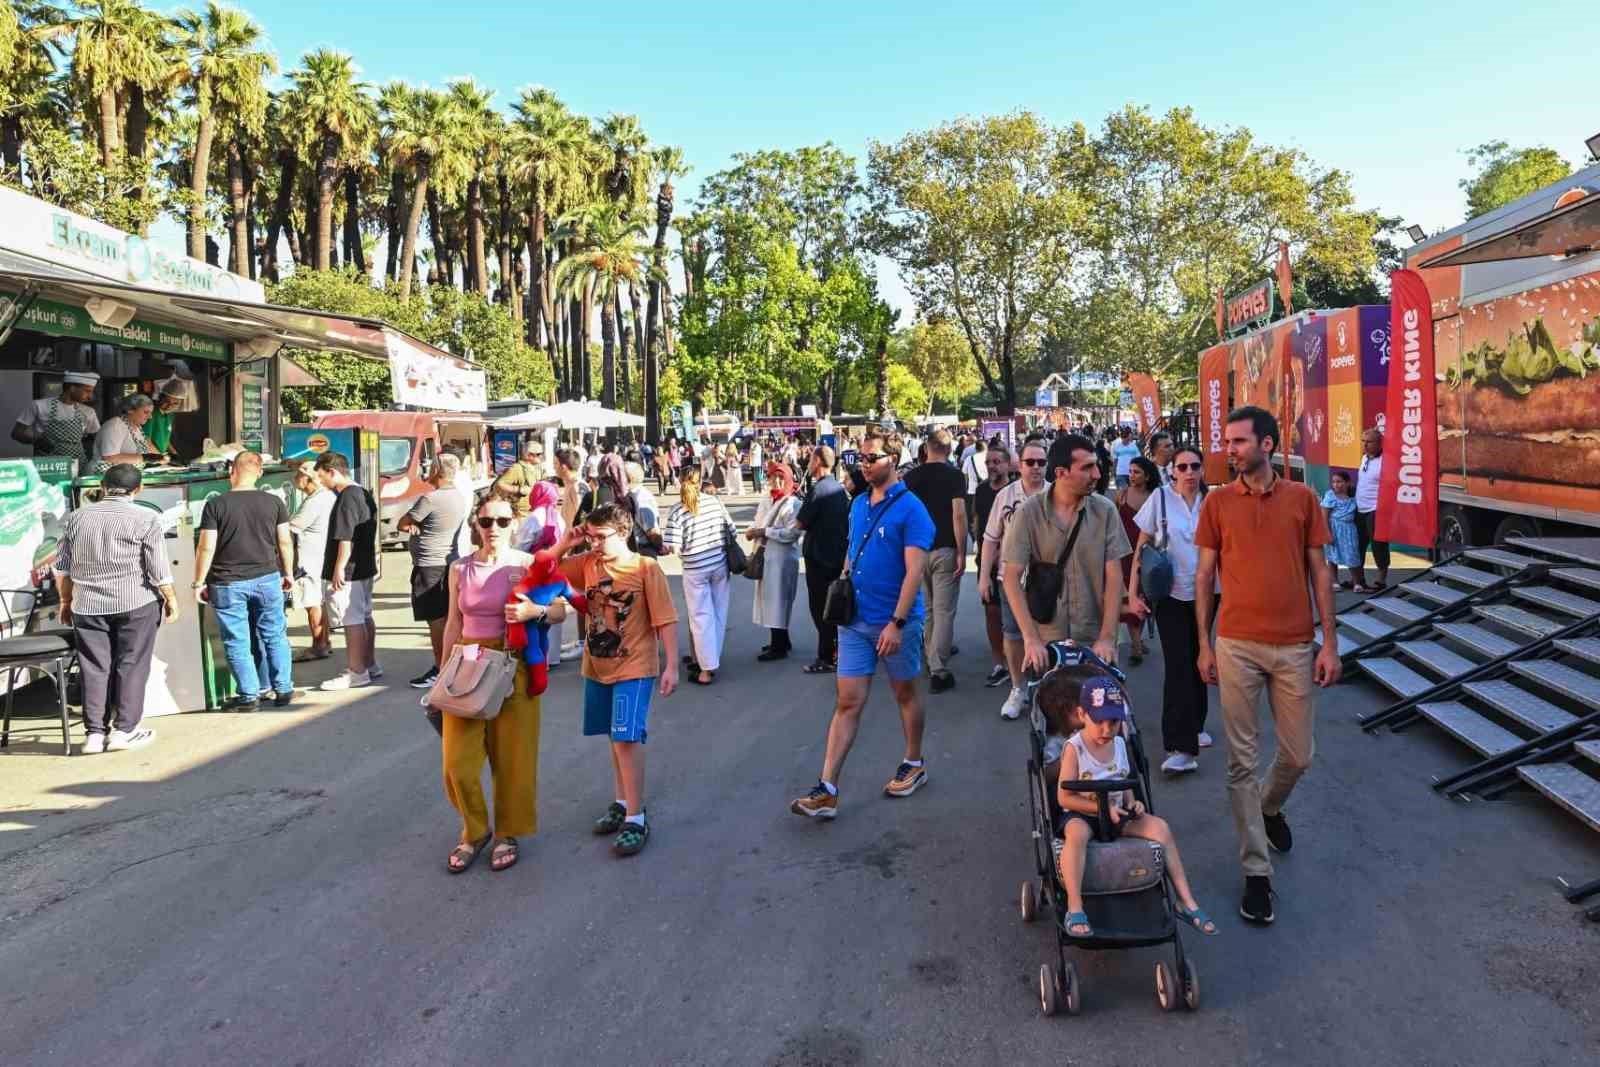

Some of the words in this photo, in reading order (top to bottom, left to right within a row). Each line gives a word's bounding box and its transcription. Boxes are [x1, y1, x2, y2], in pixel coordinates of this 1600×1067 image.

[1403, 308, 1421, 382] KING
[845, 454, 855, 465] 10
[1397, 388, 1422, 504] BURGER
